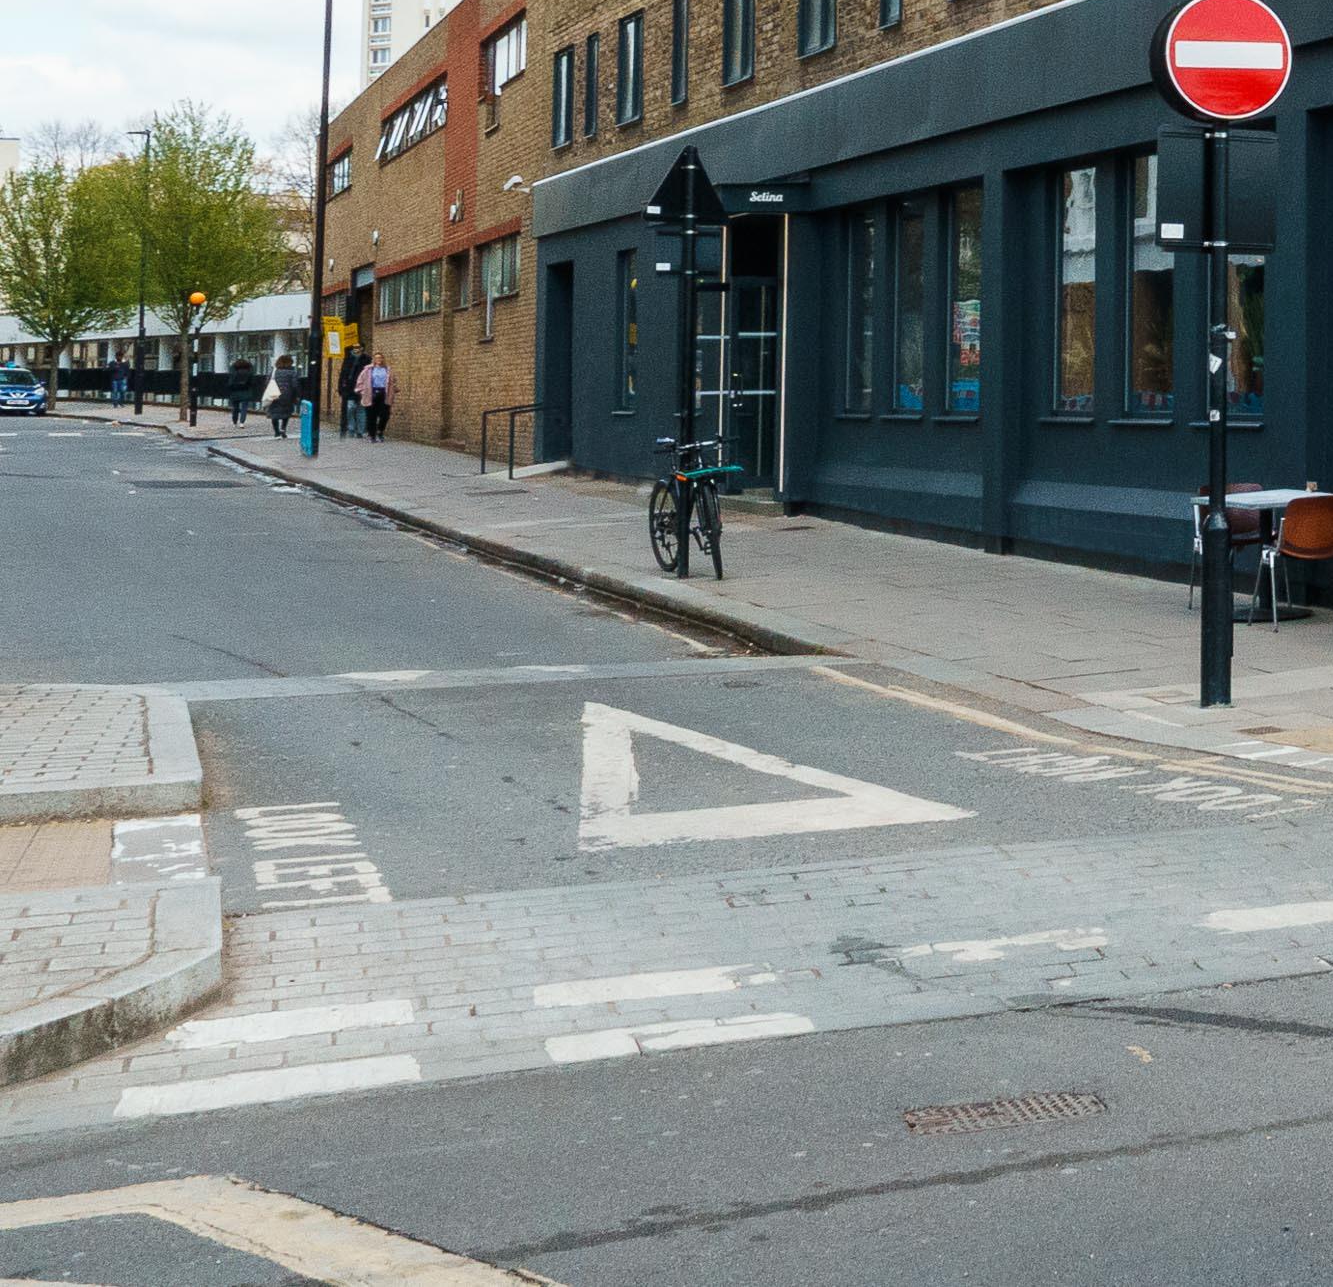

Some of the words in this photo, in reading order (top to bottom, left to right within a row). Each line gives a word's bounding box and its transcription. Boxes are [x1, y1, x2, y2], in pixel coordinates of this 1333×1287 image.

[749, 191, 784, 202] Selina
[1118, 777, 1318, 819] LOOK
[232, 801, 363, 851] LOOK
[251, 851, 394, 909] LEFT
